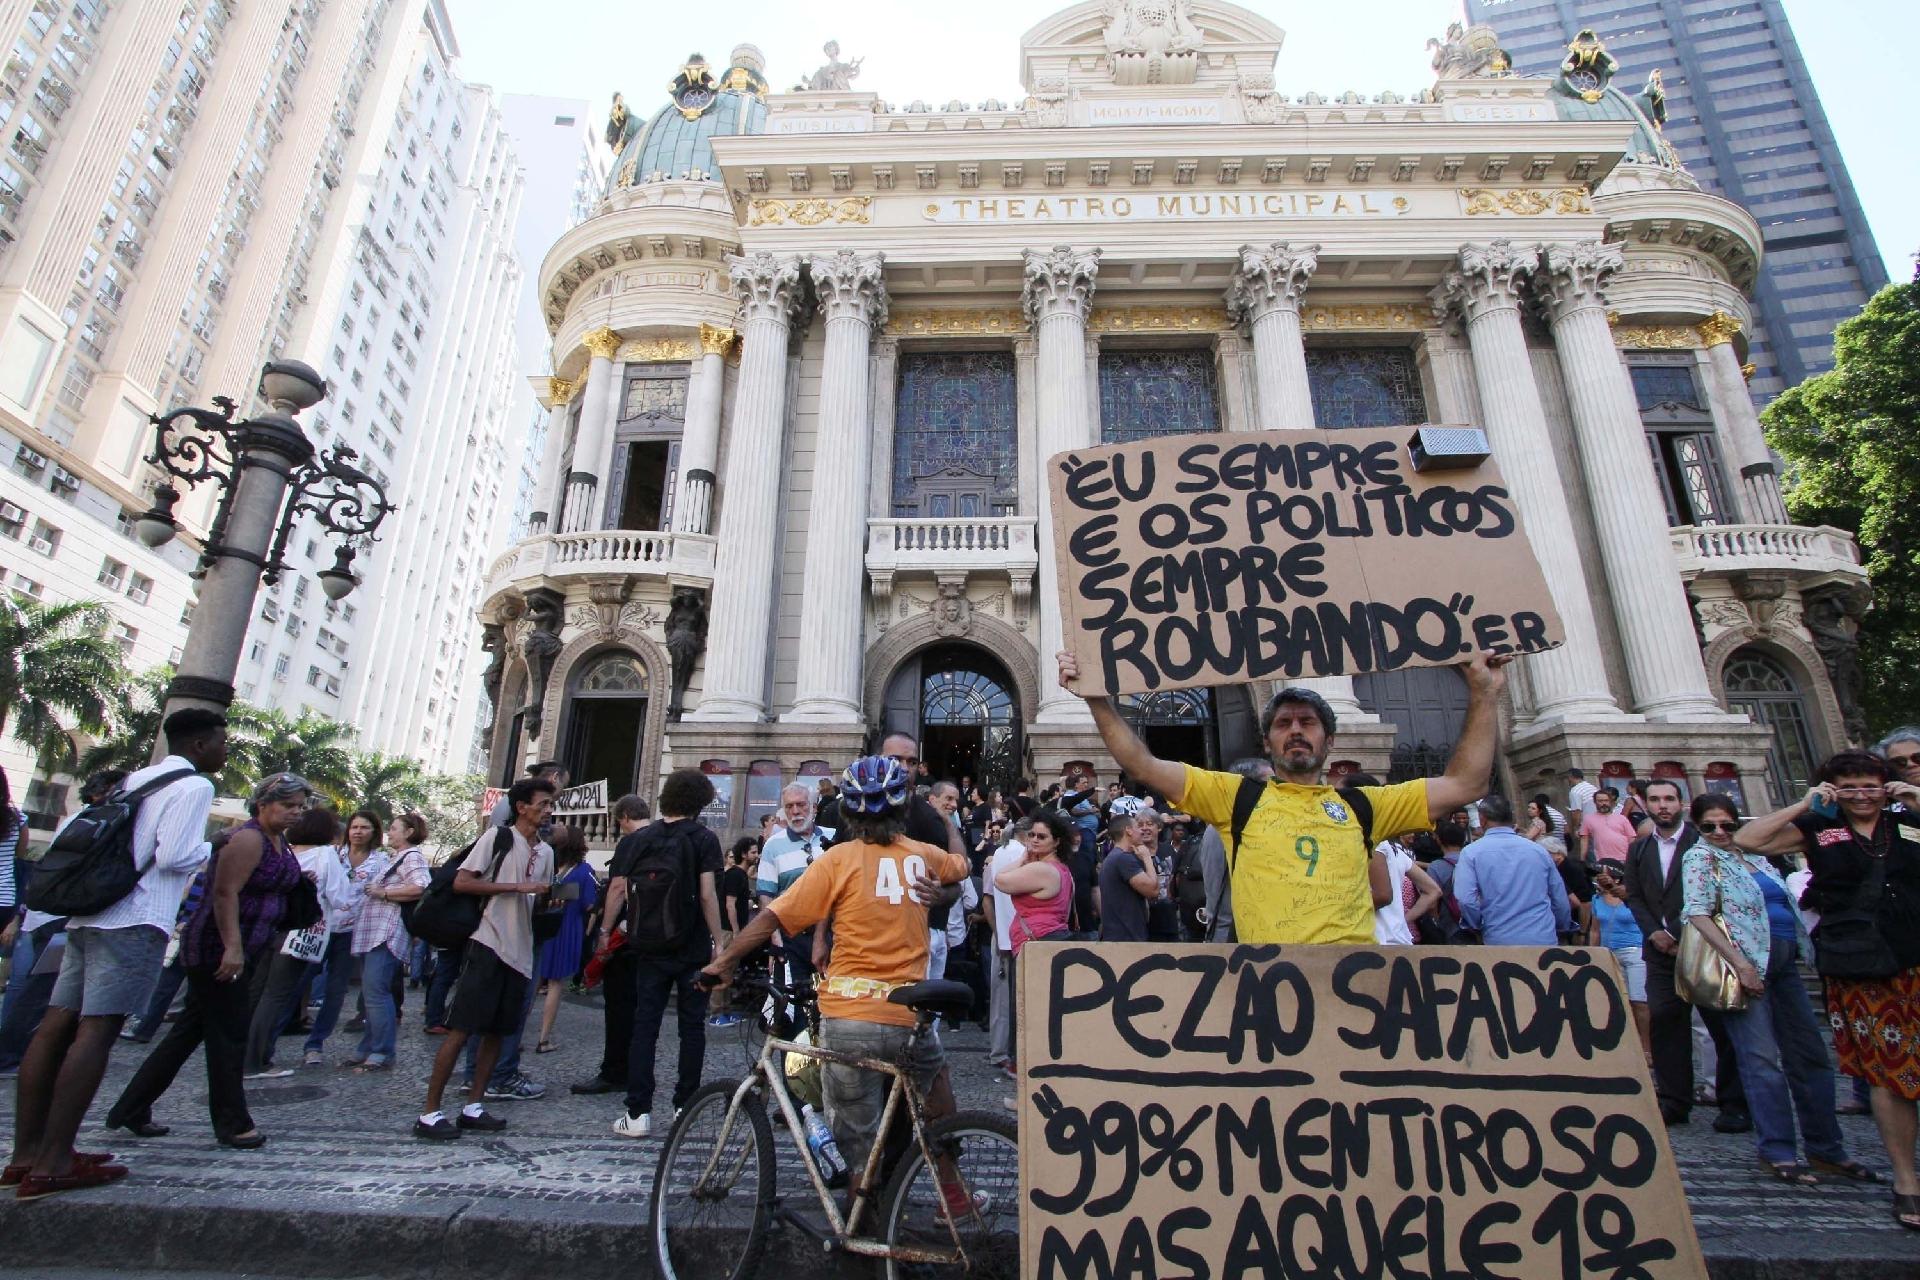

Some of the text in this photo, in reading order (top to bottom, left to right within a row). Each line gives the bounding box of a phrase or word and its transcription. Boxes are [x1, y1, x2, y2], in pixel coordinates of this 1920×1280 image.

[952, 193, 1380, 218] THEATRO MUNICIPAL
[1175, 441, 1403, 494] SEMPRE
[1069, 514, 1121, 568] E
[1138, 492, 1231, 549] OS
[1079, 542, 1328, 632] SEMPRE
[1295, 835, 1320, 878] 9
[1049, 943, 1627, 1065] PEZÃO SAFADÃO
[1035, 1206, 1212, 1280] MAS
[1222, 1191, 1524, 1280] AQUELE
